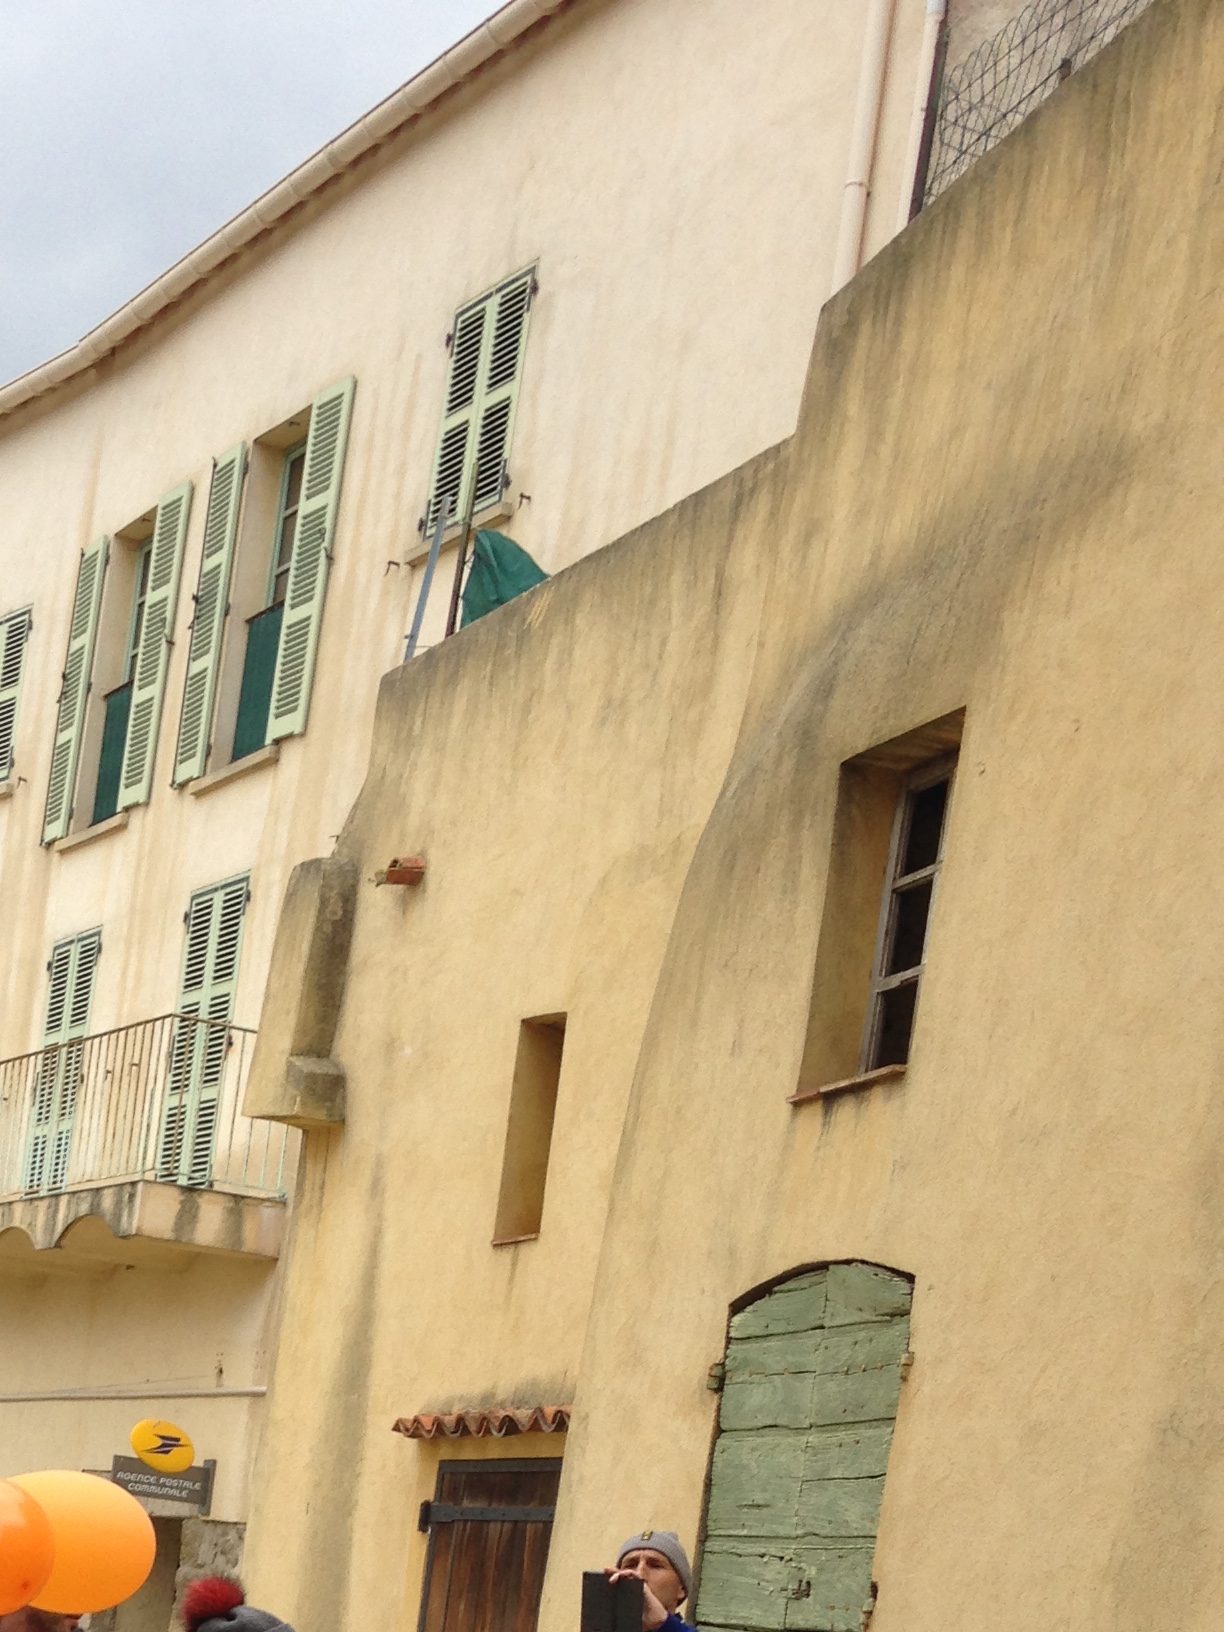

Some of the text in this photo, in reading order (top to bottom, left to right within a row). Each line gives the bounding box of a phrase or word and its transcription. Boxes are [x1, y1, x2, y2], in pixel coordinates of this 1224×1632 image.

[117, 1471, 202, 1490] AGENCE POSTALE
[128, 1482, 189, 1498] COMMUNALE
